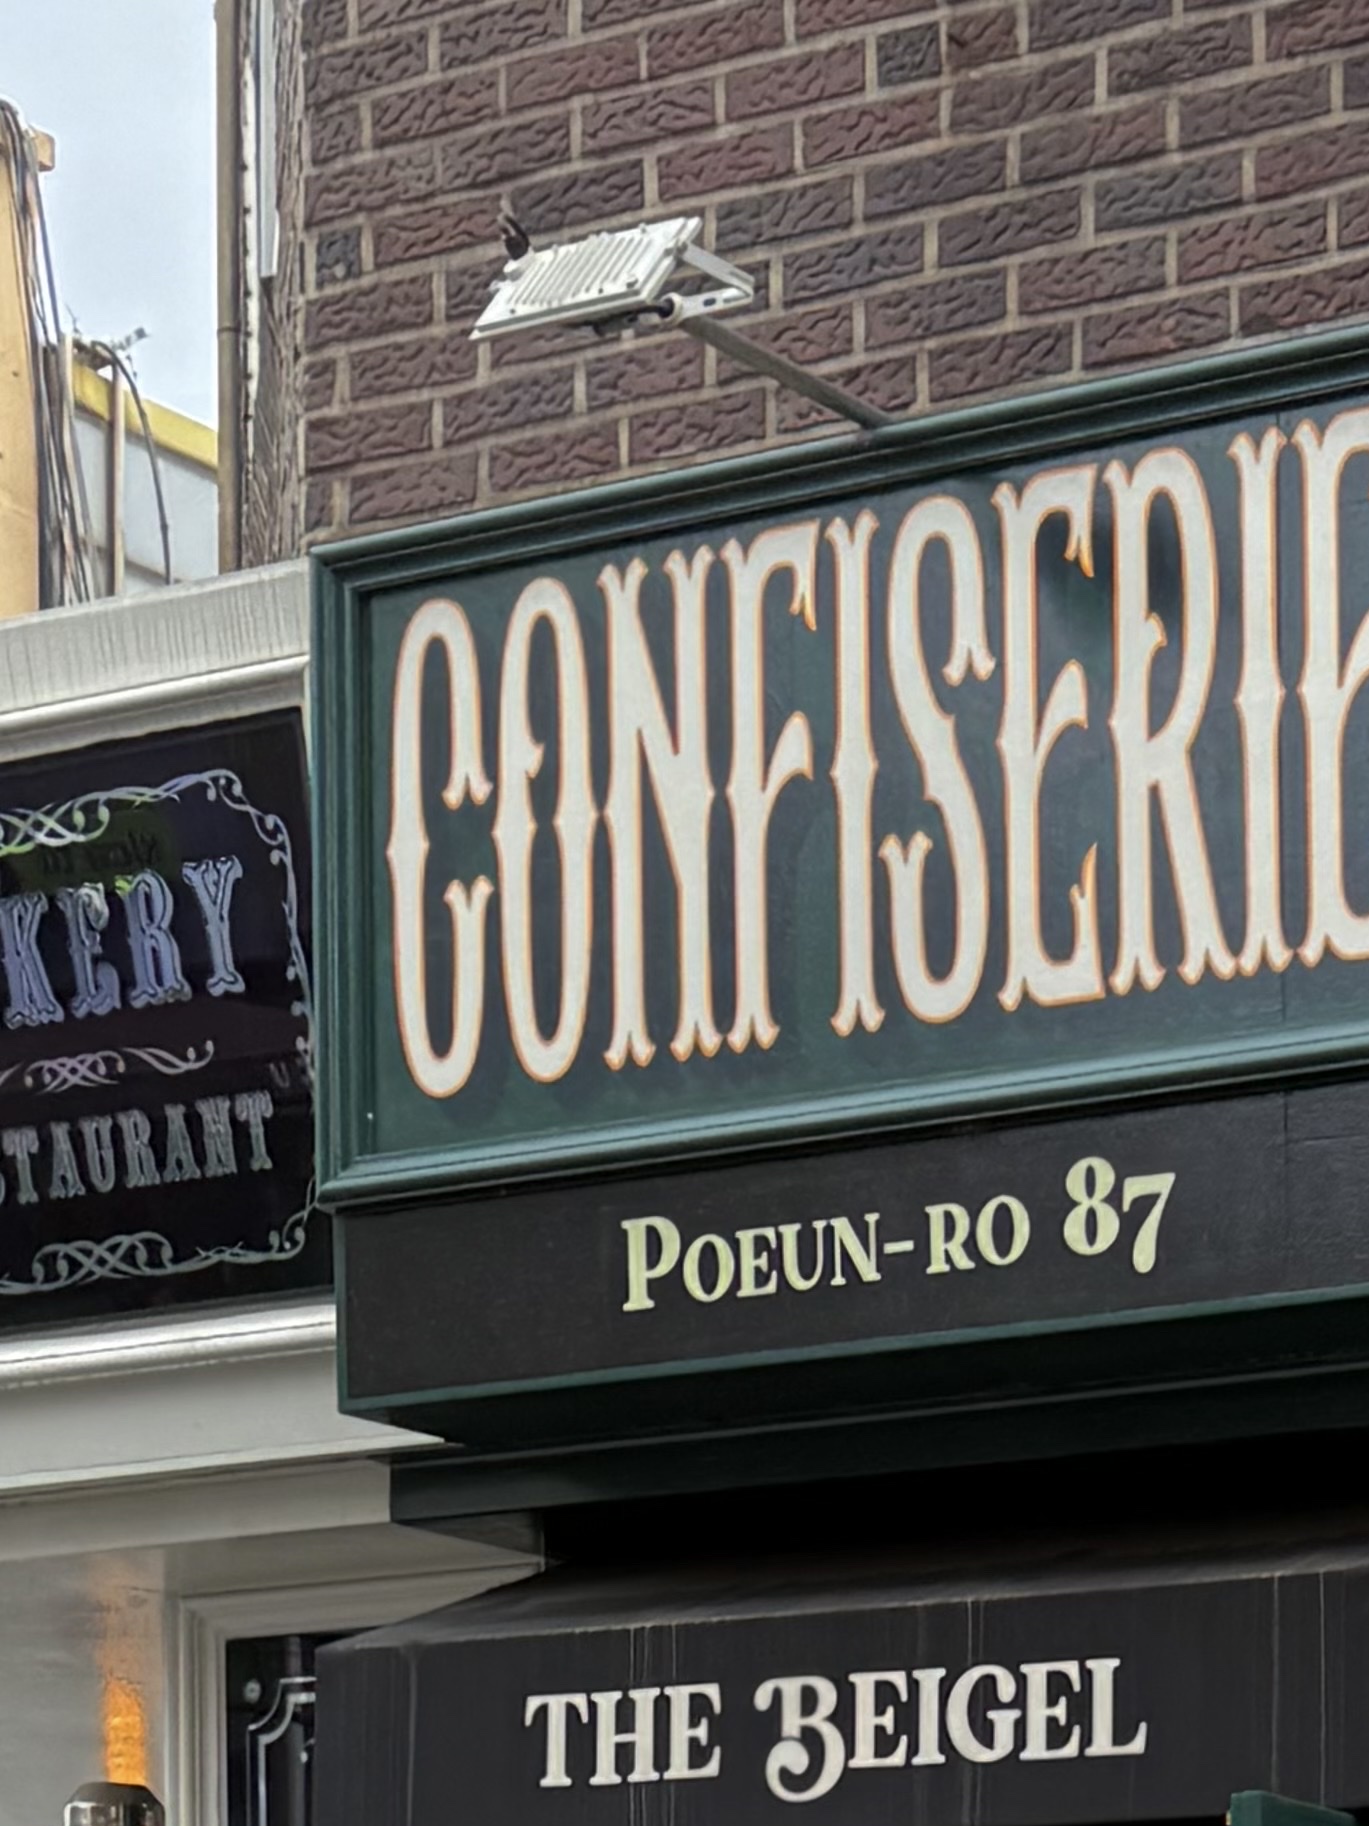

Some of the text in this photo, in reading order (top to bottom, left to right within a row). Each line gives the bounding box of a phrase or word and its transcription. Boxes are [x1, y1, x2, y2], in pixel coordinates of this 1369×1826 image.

[620, 1155, 1176, 1312] POEUN-RO 87
[523, 1656, 1149, 1802] THE BEIGEL
